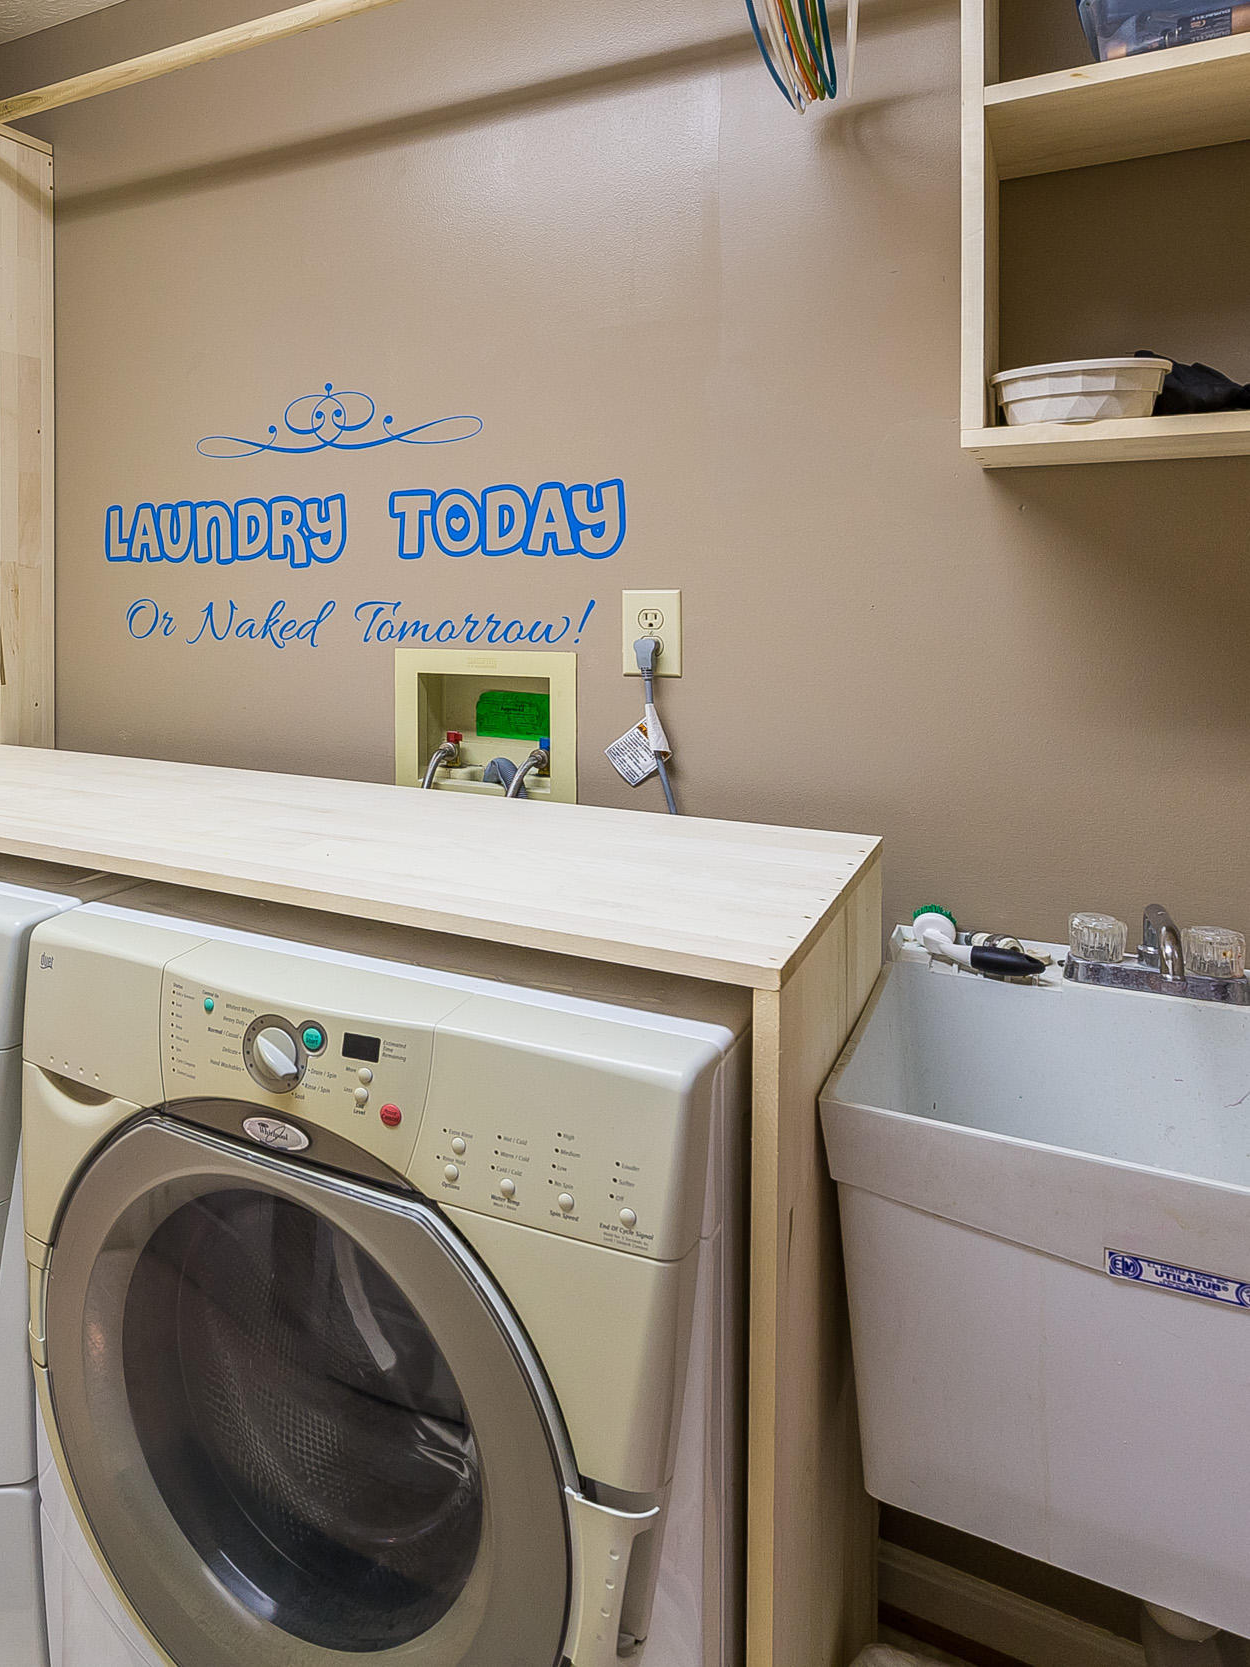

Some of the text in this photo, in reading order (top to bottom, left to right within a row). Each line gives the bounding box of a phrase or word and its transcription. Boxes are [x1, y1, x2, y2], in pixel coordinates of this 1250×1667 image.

[105, 478, 627, 569] LAUNDRY TODAY
[126, 598, 596, 649] Or Naked Tomorrow!
[258, 1122, 288, 1141] Whirlpool
